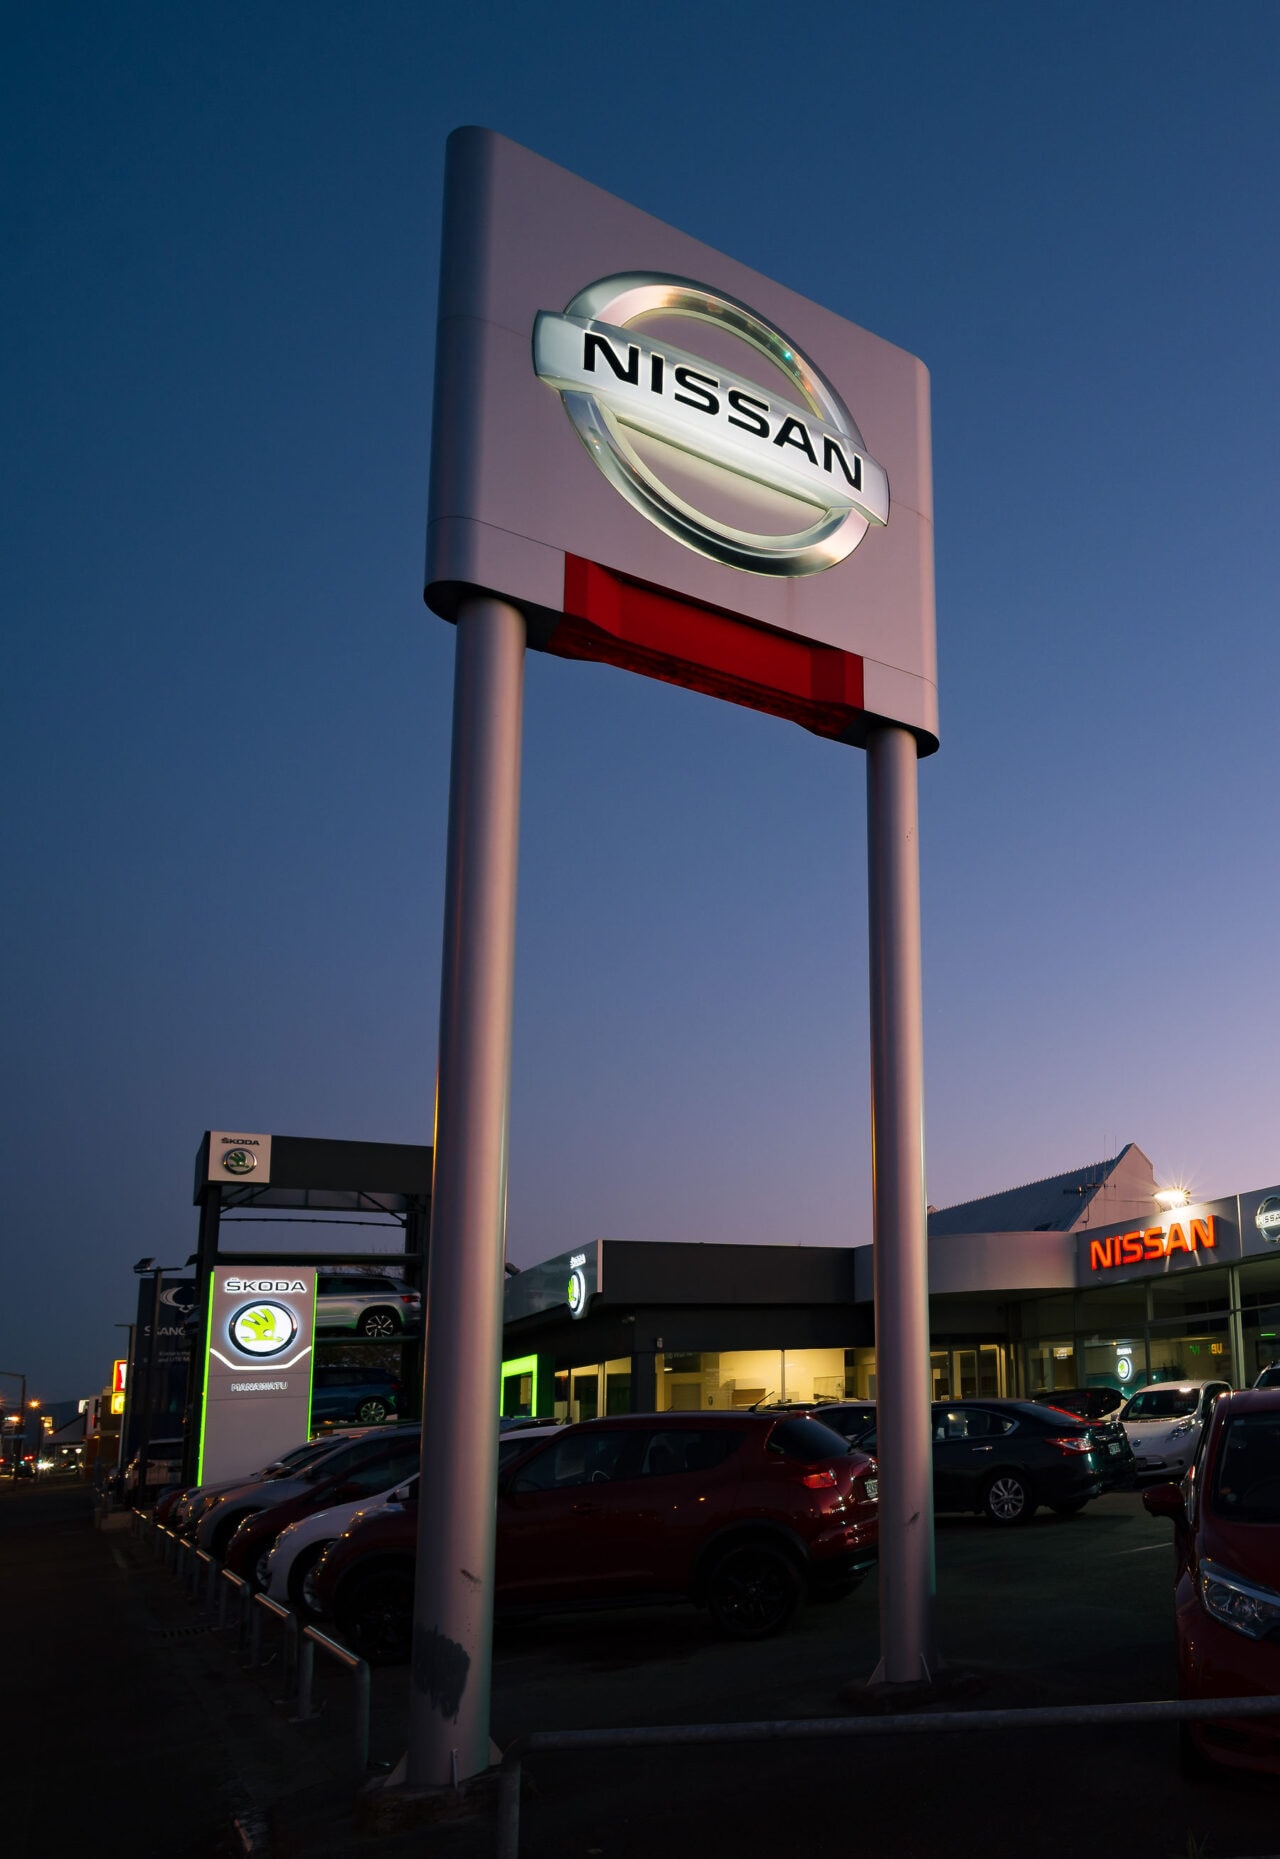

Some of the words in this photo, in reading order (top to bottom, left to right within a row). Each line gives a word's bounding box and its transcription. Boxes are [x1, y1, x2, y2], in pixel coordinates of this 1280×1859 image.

[583, 332, 863, 492] NISSAN
[1089, 1214, 1216, 1271] NISSAN
[226, 1277, 307, 1292] ŠKODA
